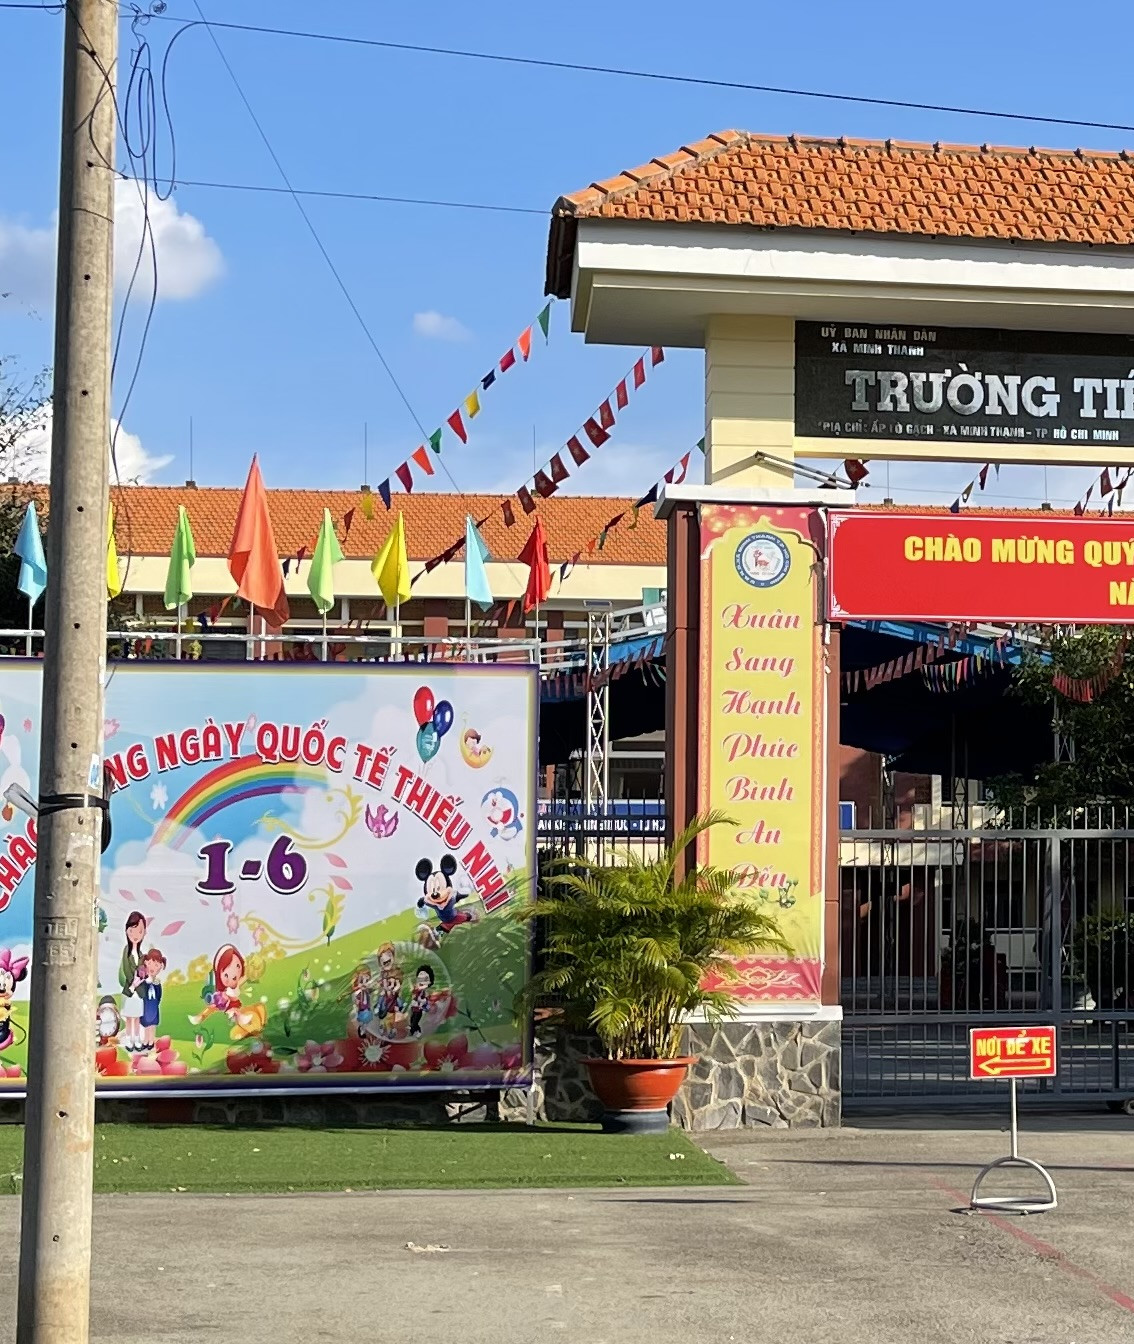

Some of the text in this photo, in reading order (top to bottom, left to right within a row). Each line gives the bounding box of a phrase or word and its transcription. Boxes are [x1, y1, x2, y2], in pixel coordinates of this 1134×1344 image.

[844, 327, 868, 339] BAN
[853, 343, 882, 355] MINH
[845, 363, 1060, 417] TRƯỜNG
[960, 425, 988, 437] MINH
[1092, 430, 1119, 441] MINH
[904, 533, 982, 562] CHÀO
[991, 535, 1075, 564] MỪNG
[721, 604, 801, 629] Xuân
[725, 647, 795, 677] Sang
[721, 690, 801, 719] Hạnh
[722, 733, 799, 763] Phúc
[155, 718, 246, 770] NGÀY
[256, 719, 347, 770] QUỐC
[354, 743, 395, 788] TẾ
[392, 764, 473, 849] THIẾU
[462, 840, 511, 912] NHI
[735, 820, 781, 844] An
[197, 834, 309, 893] 1-6
[731, 863, 787, 889] Đến
[976, 1029, 1051, 1056] NƠI ĐỂ XE
